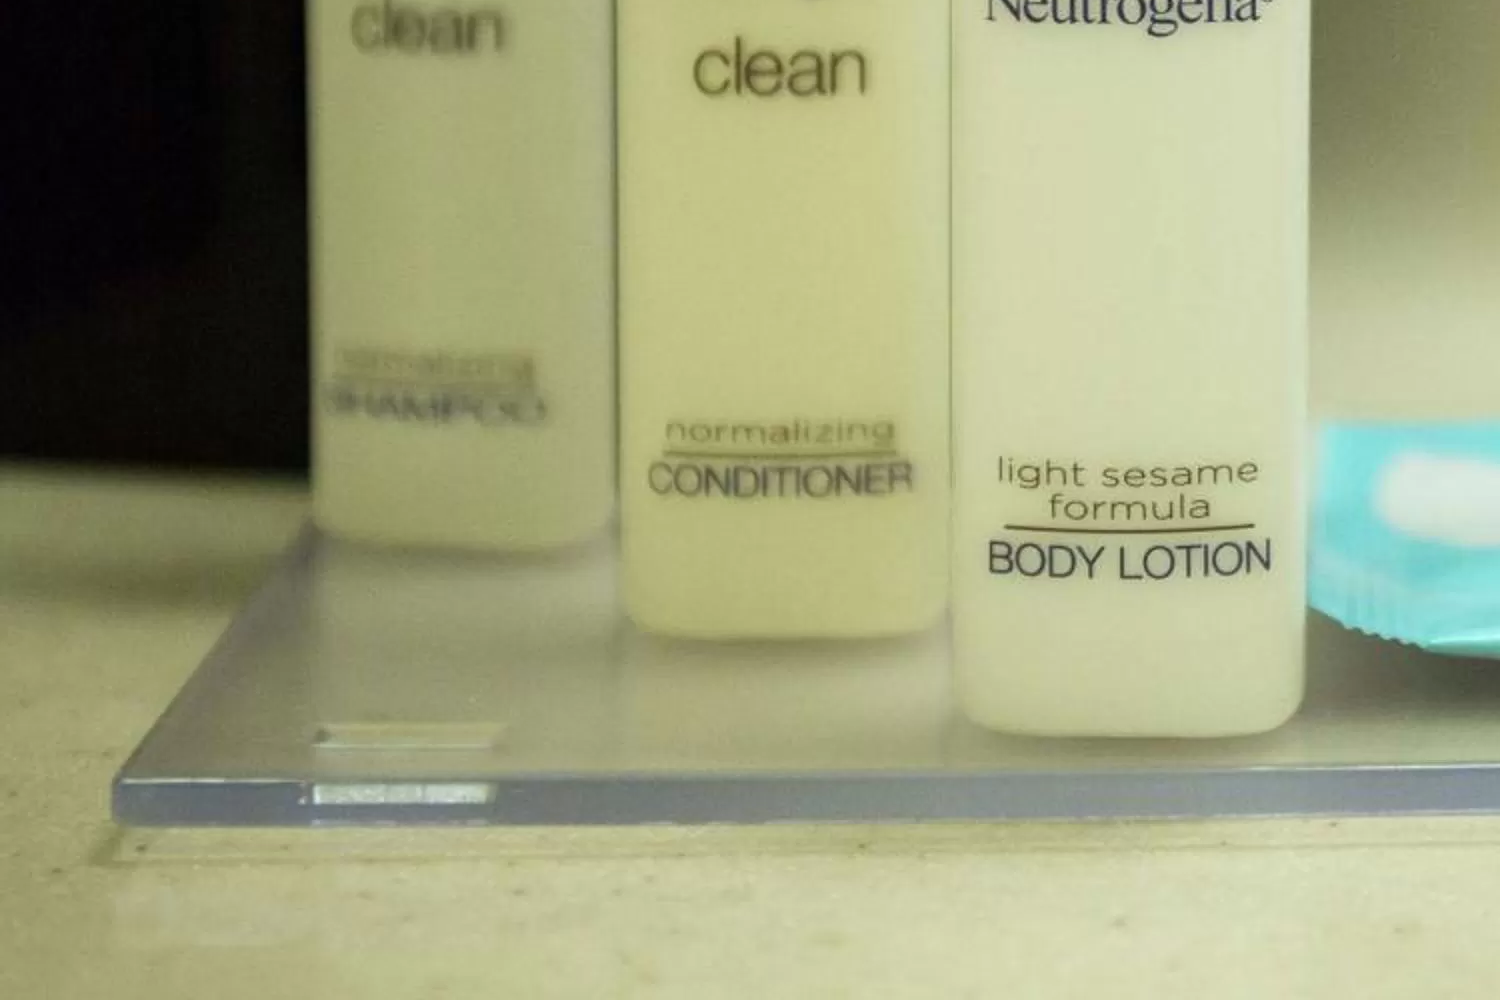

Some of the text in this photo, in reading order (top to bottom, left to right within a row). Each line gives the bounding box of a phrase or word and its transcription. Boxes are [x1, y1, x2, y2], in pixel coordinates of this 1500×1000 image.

[693, 36, 868, 97] clean
[664, 419, 897, 454] normalizing
[649, 462, 914, 498] CONDITIONER
[997, 456, 1259, 490] light sesame
[1048, 492, 1212, 521] formula
[988, 539, 1273, 580] BODY LOTION
